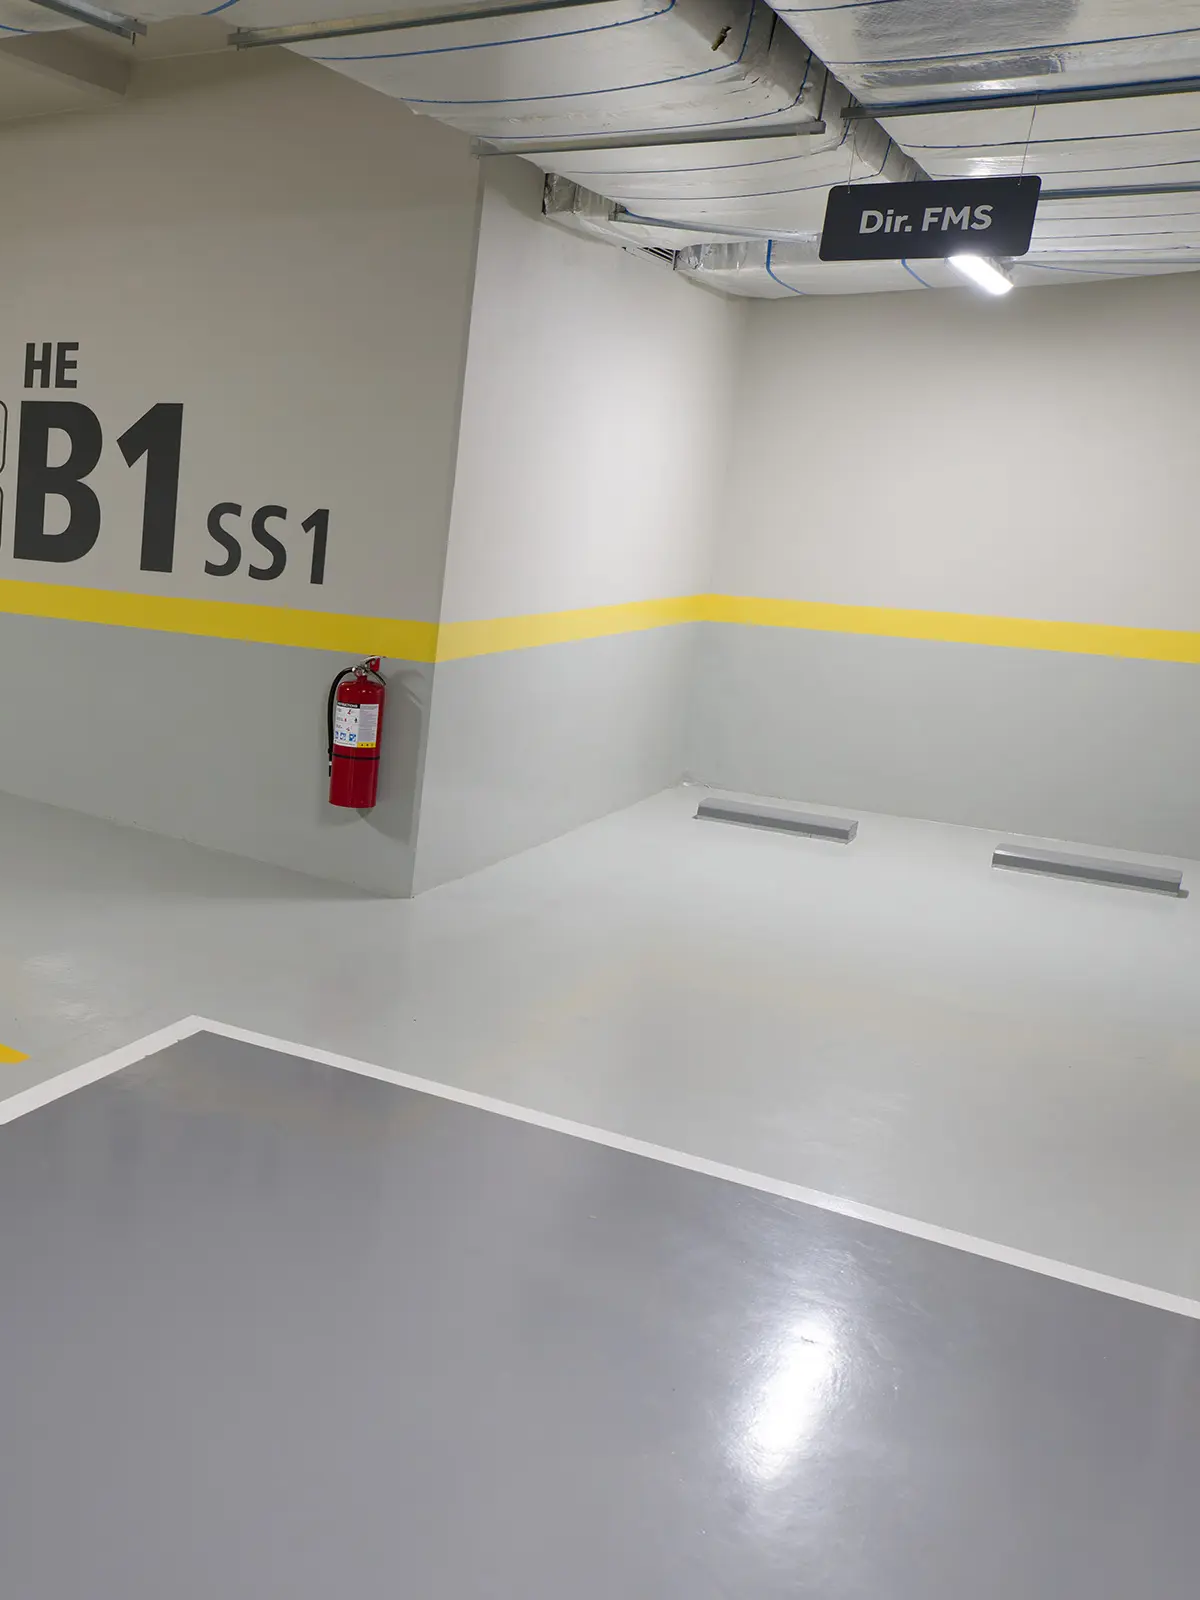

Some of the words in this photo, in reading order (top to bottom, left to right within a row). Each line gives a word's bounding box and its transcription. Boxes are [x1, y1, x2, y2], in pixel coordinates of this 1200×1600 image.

[859, 210, 913, 234] Dir.
[921, 204, 994, 232] FMS
[23, 341, 80, 389] HE
[13, 400, 184, 574] B1
[204, 501, 330, 585] SS1
